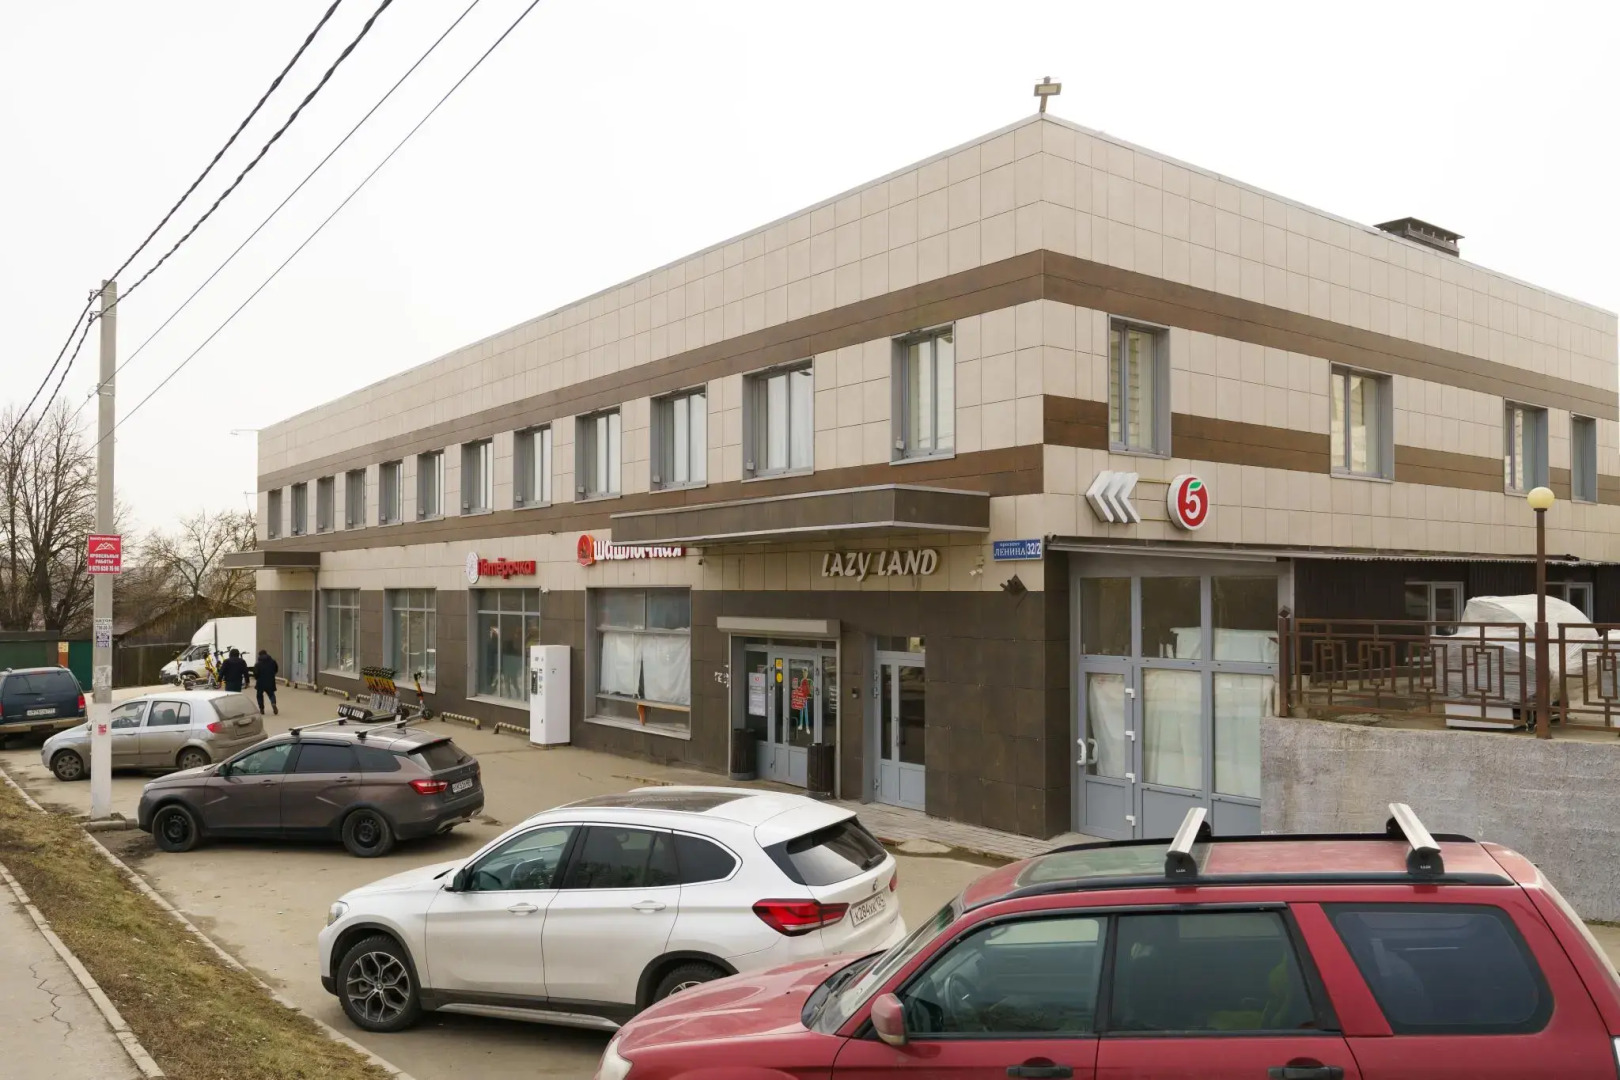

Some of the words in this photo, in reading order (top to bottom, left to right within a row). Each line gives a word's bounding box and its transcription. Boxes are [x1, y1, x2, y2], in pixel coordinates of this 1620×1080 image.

[1185, 480, 1202, 519] 5
[994, 547, 1026, 557] ЛЕНИНА
[1026, 542, 1041, 555] 32/2
[479, 558, 536, 579] Пятёрочка
[821, 552, 871, 582] LAZY
[878, 549, 937, 576] LAND
